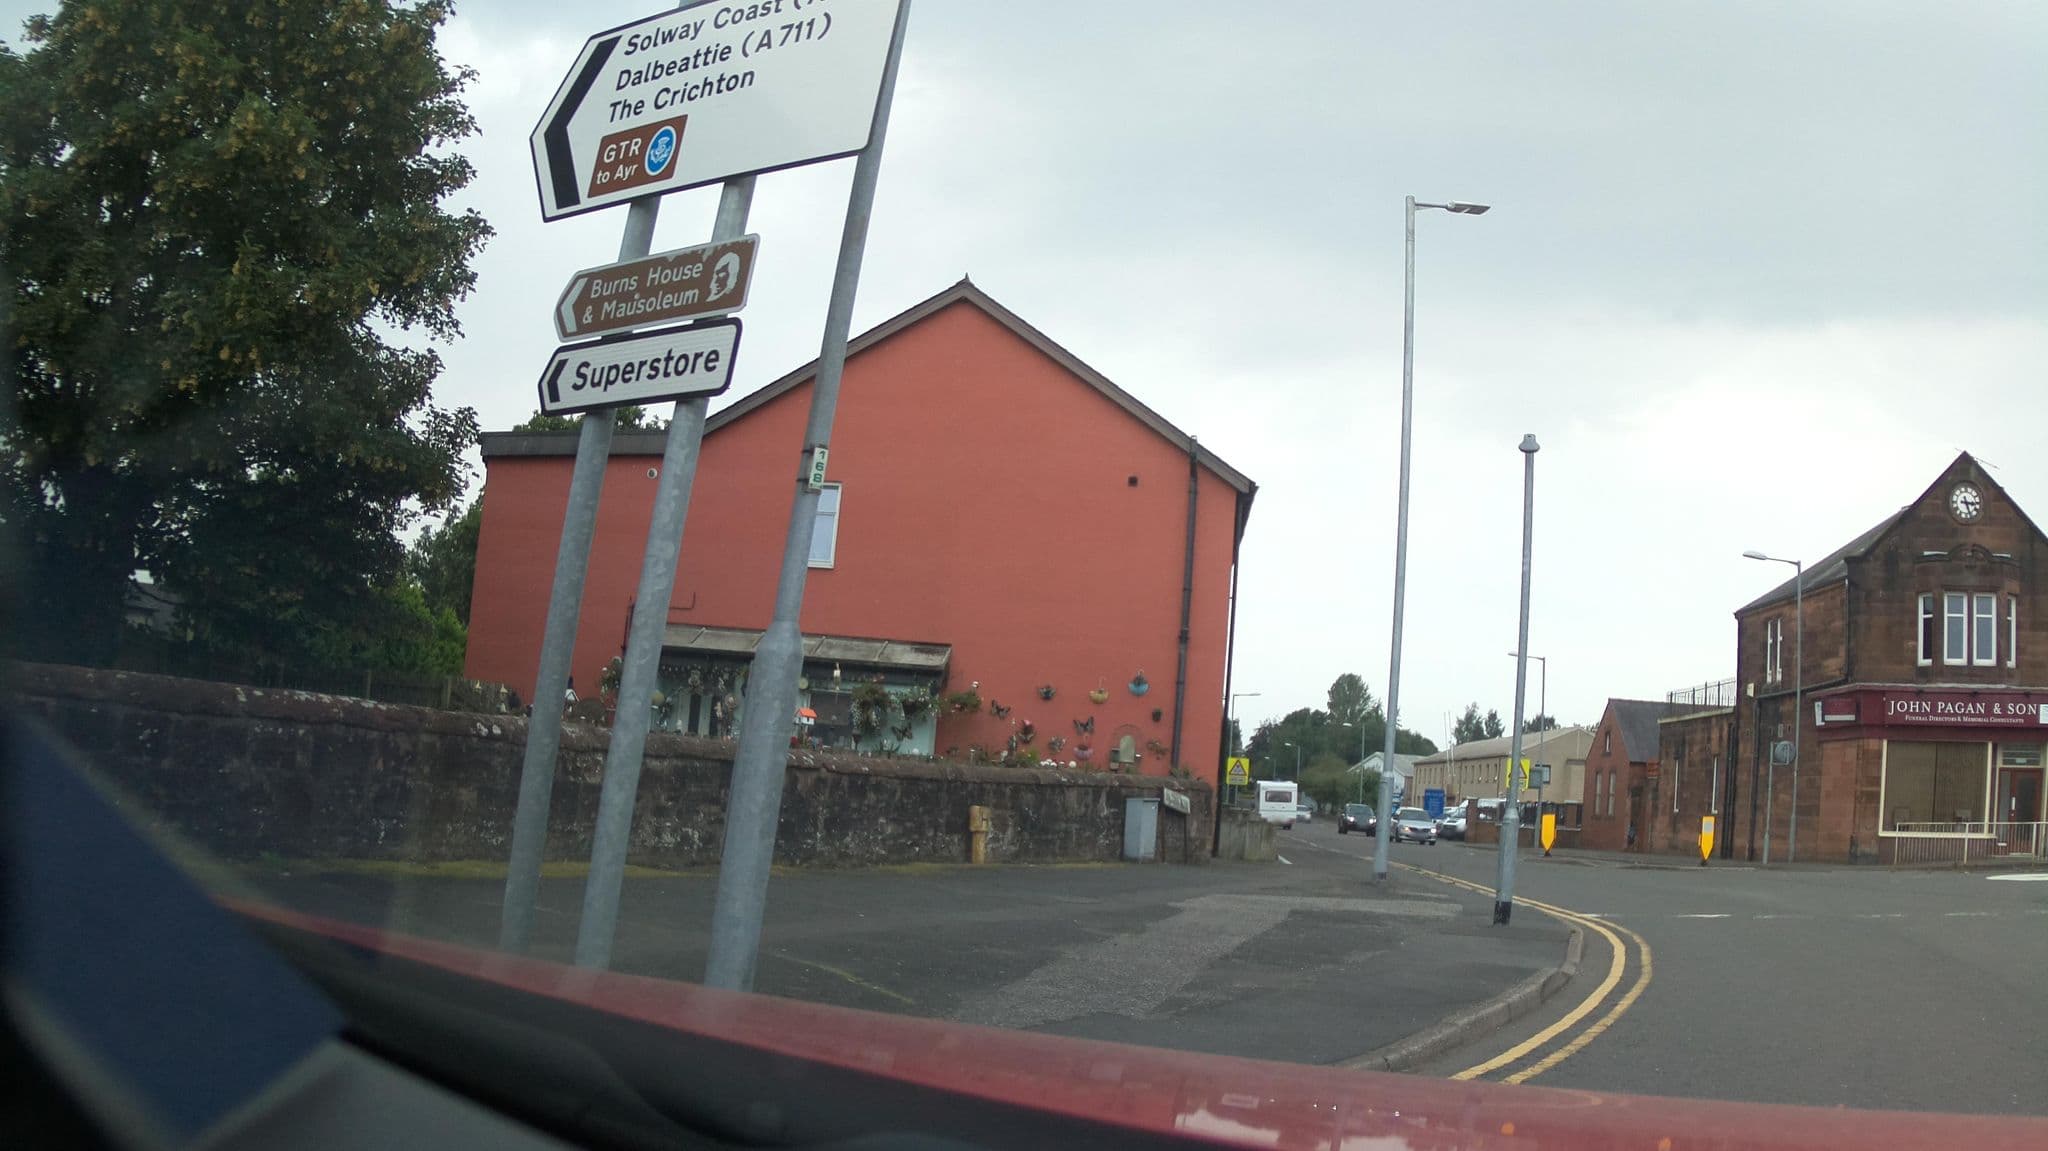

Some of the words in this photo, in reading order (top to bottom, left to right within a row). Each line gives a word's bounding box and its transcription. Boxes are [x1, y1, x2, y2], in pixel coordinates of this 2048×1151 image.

[624, 19, 706, 56] Solway
[713, 0, 783, 29] Coast
[615, 42, 732, 91] Dalbeattie
[608, 97, 645, 123] The
[653, 70, 755, 110] Crichton
[603, 138, 642, 164] GTR
[596, 169, 609, 185] to
[614, 163, 637, 183] Ayr
[590, 274, 638, 298] Burns
[646, 262, 703, 287] House
[582, 306, 593, 324] &
[600, 288, 699, 320] Mausoleum
[571, 348, 720, 392] Superstore
[1888, 700, 1931, 715] JOHN
[1937, 701, 1985, 715] PAGAN
[1993, 703, 2002, 714] &
[2007, 703, 2037, 715] SON
